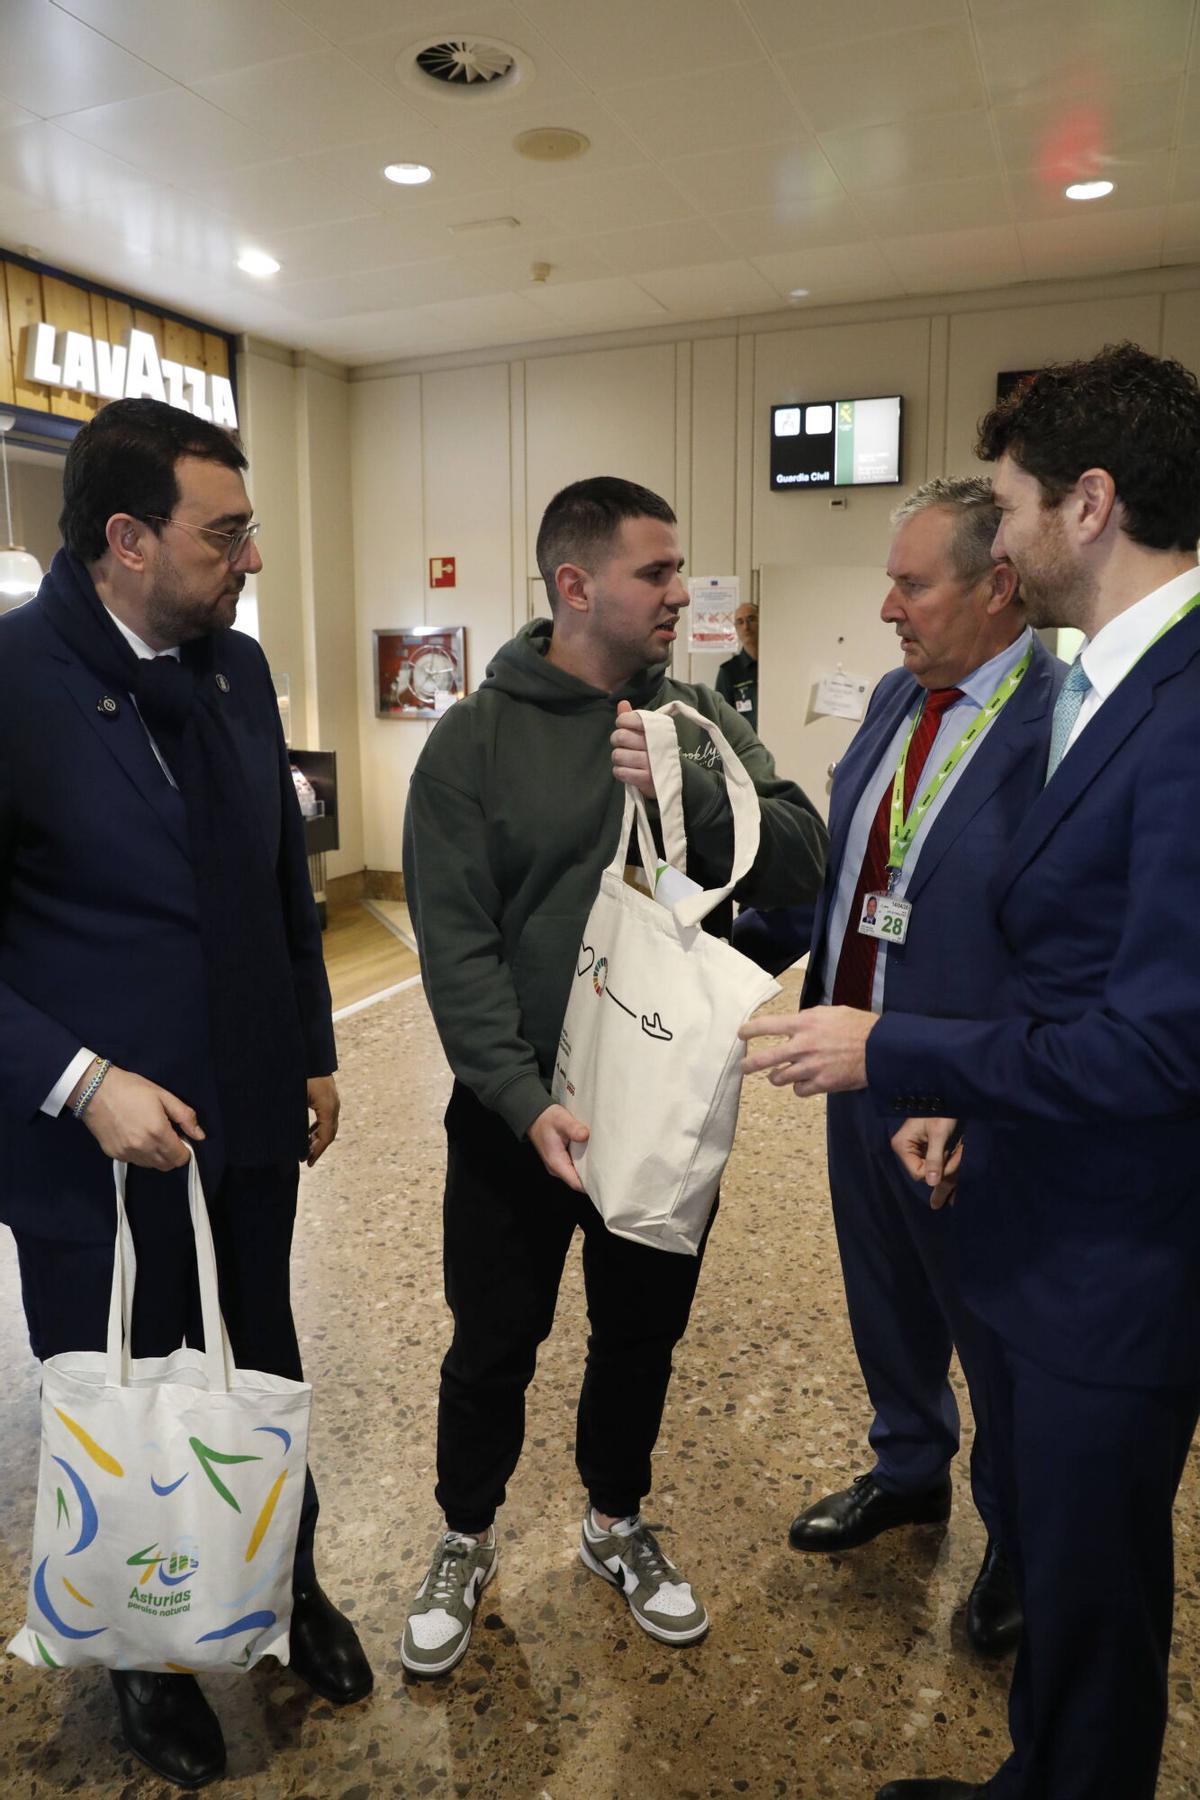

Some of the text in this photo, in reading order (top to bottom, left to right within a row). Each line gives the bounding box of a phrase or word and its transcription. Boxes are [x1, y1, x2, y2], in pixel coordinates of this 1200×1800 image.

[32, 322, 238, 430] LAVAZZA
[776, 471, 830, 484] Guardia Civil
[881, 915, 903, 936] 28
[129, 1586, 192, 1607] Asturias
[159, 1603, 191, 1617] natural
